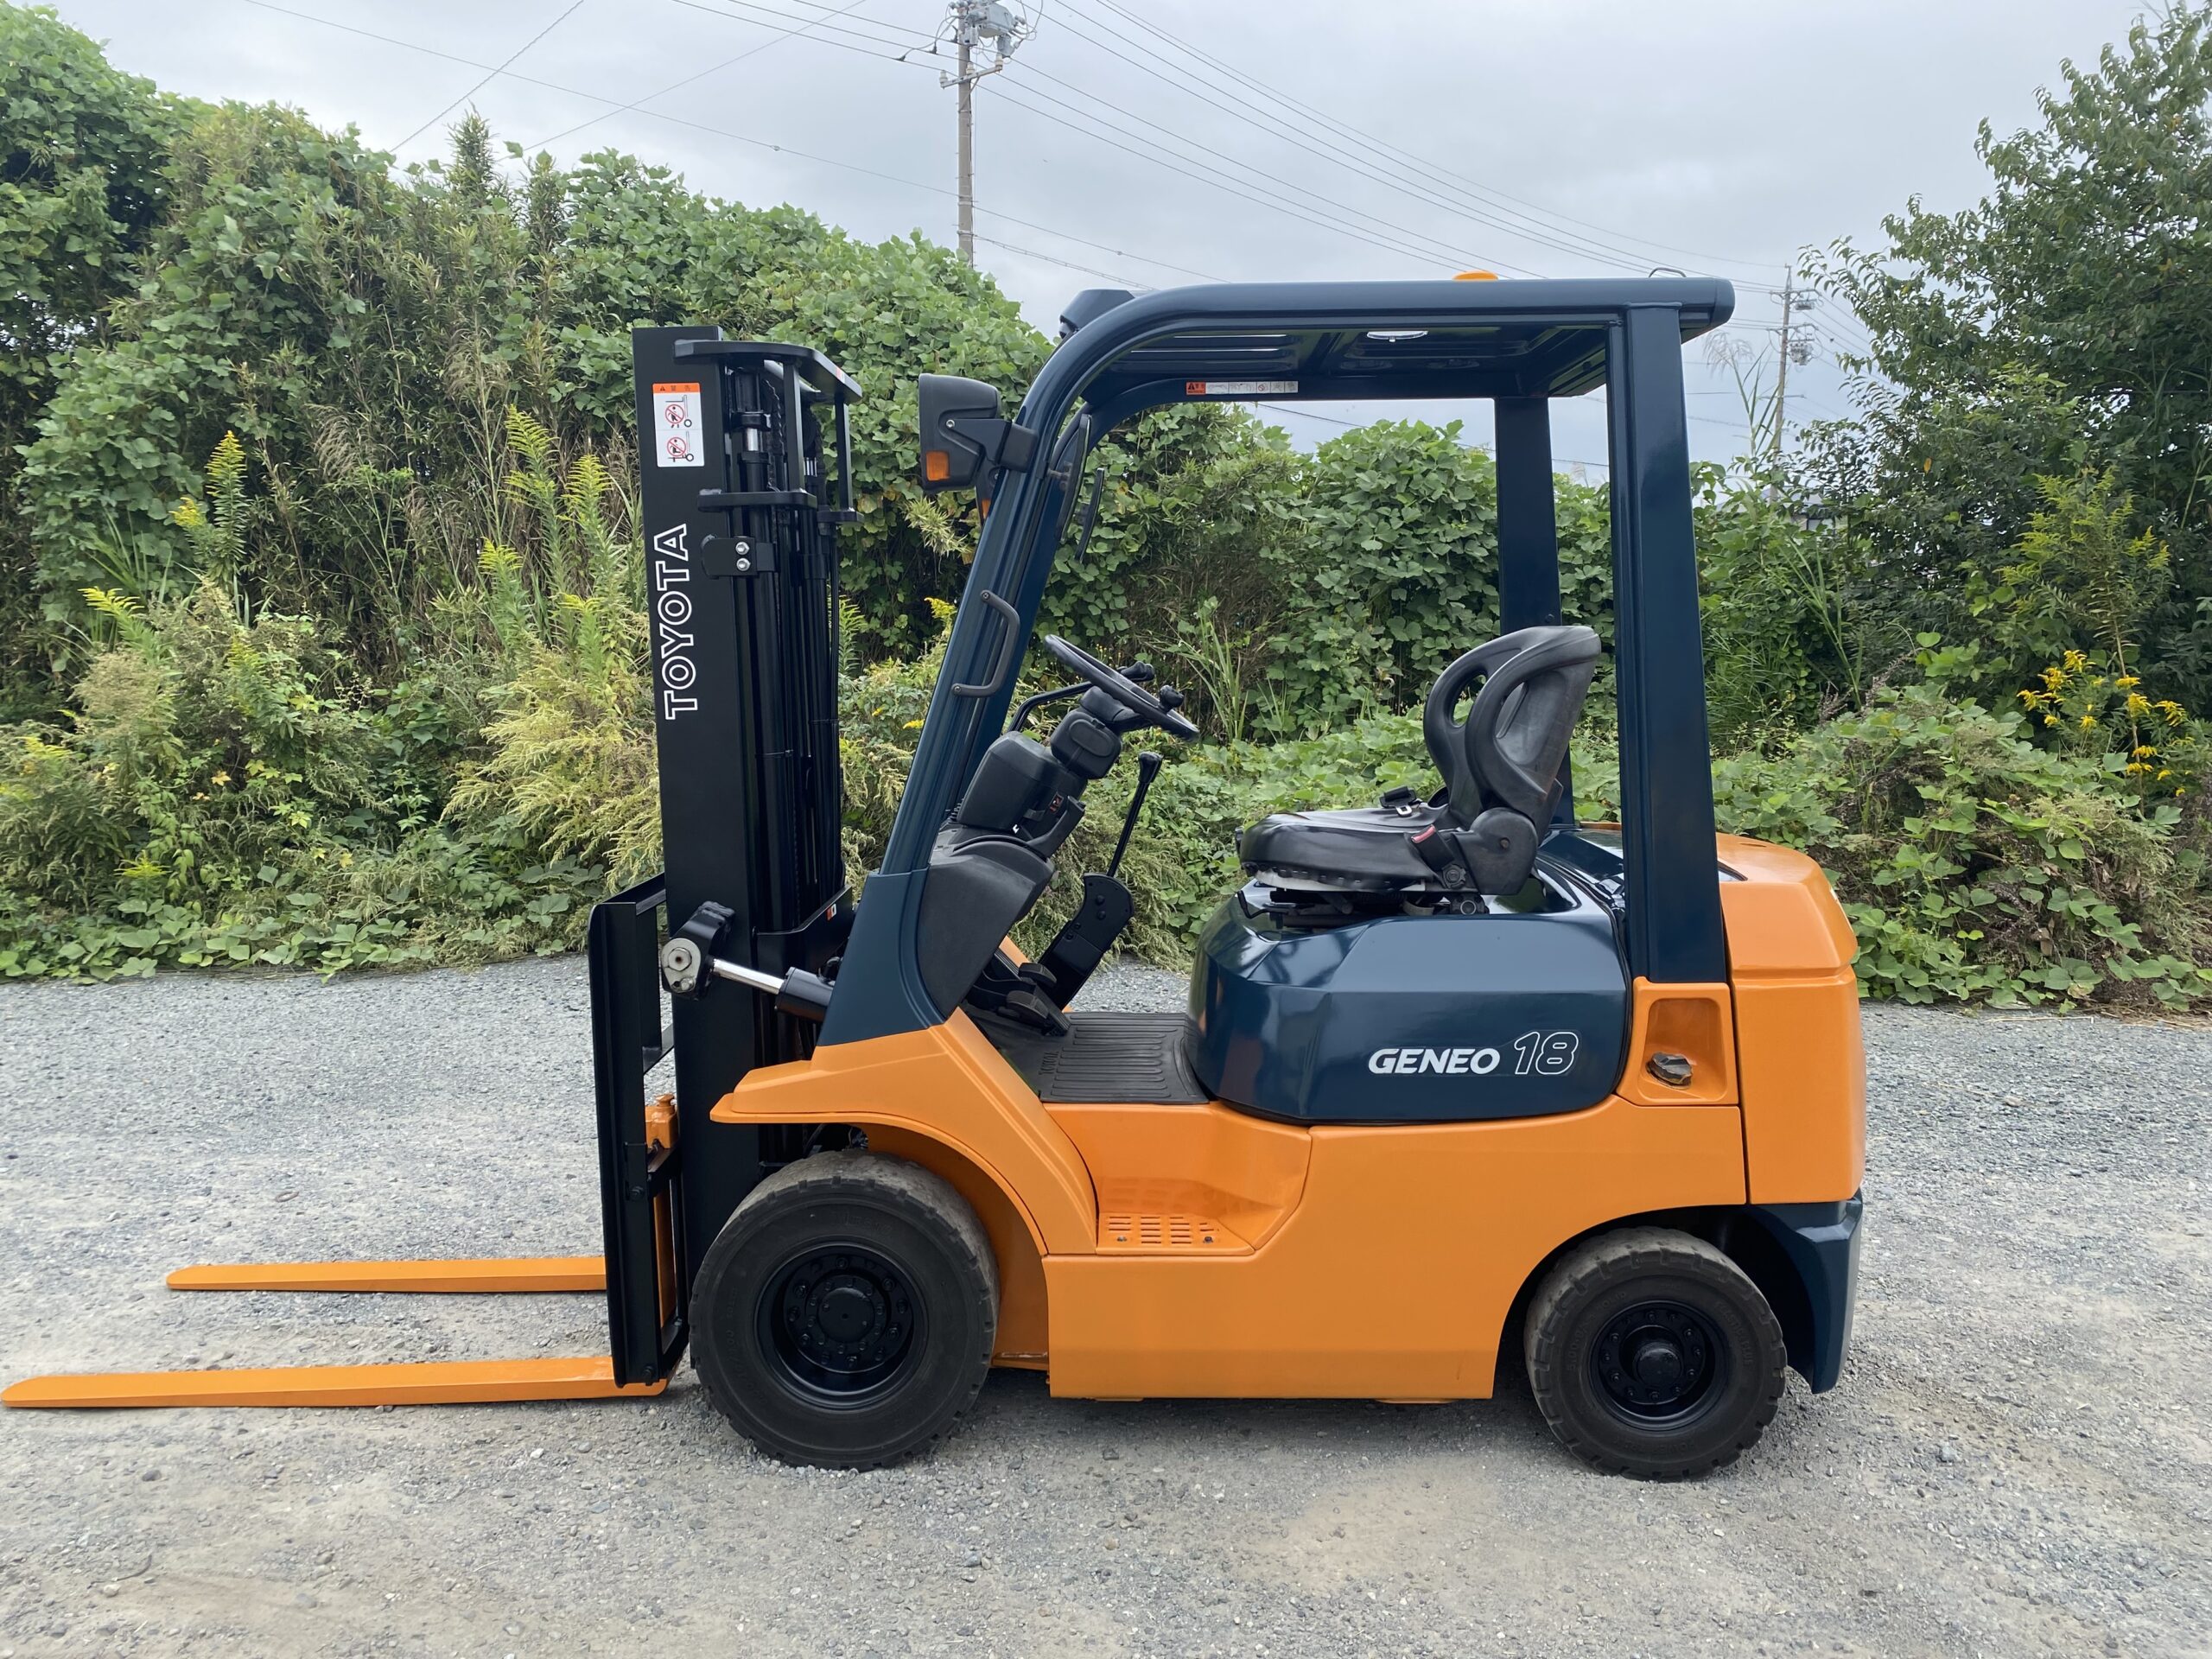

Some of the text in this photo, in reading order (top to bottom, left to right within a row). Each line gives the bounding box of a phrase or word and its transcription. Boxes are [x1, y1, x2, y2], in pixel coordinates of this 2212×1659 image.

[653, 523, 698, 721] TOYOTA
[1368, 1030, 1580, 1076] GENEO 18
